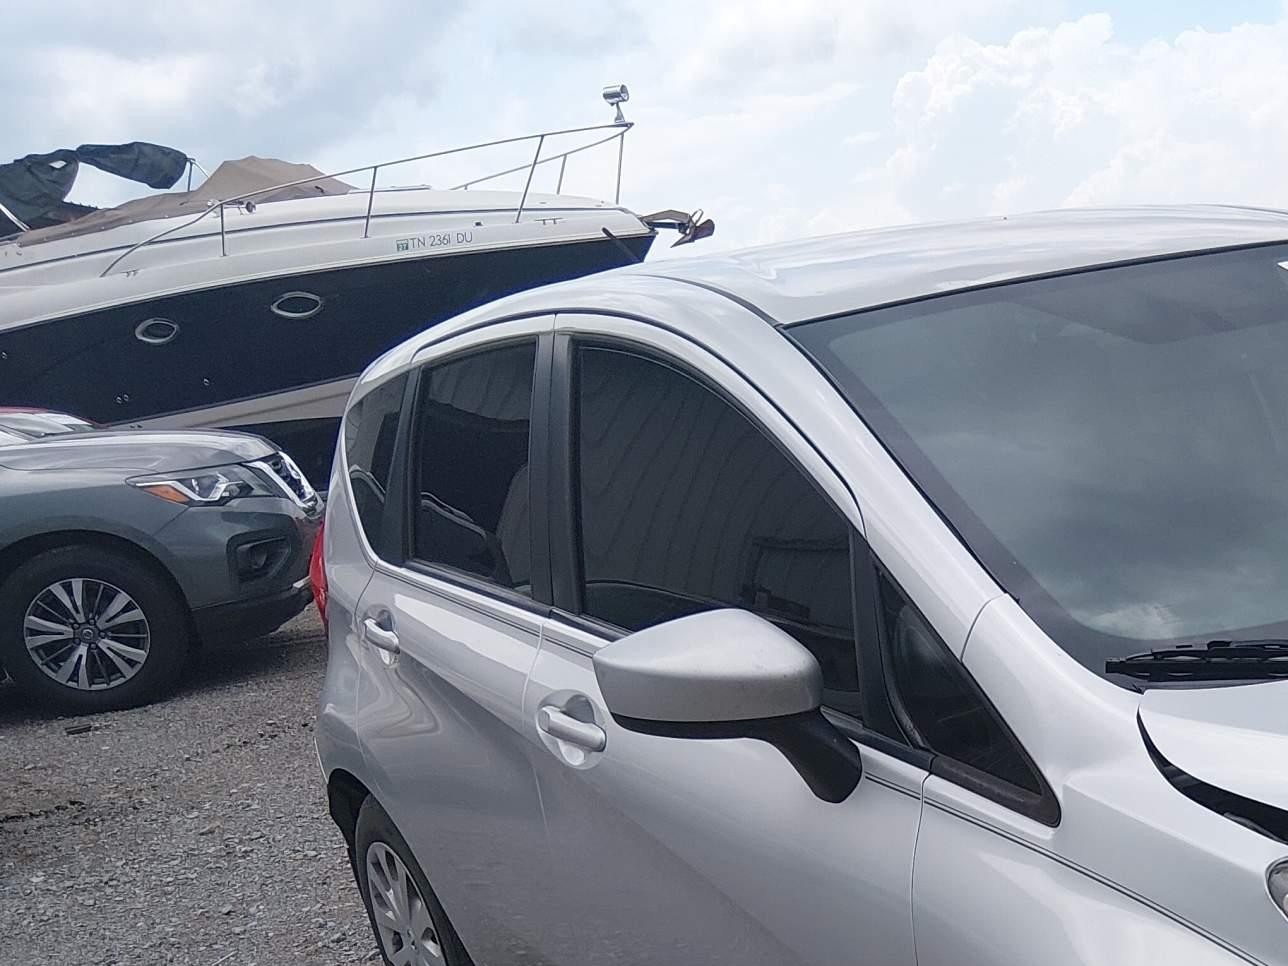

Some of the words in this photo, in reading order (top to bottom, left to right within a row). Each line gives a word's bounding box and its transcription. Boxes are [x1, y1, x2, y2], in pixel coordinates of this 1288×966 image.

[409, 236, 426, 249] TN
[429, 233, 451, 247] 2361
[456, 231, 473, 244] DU
